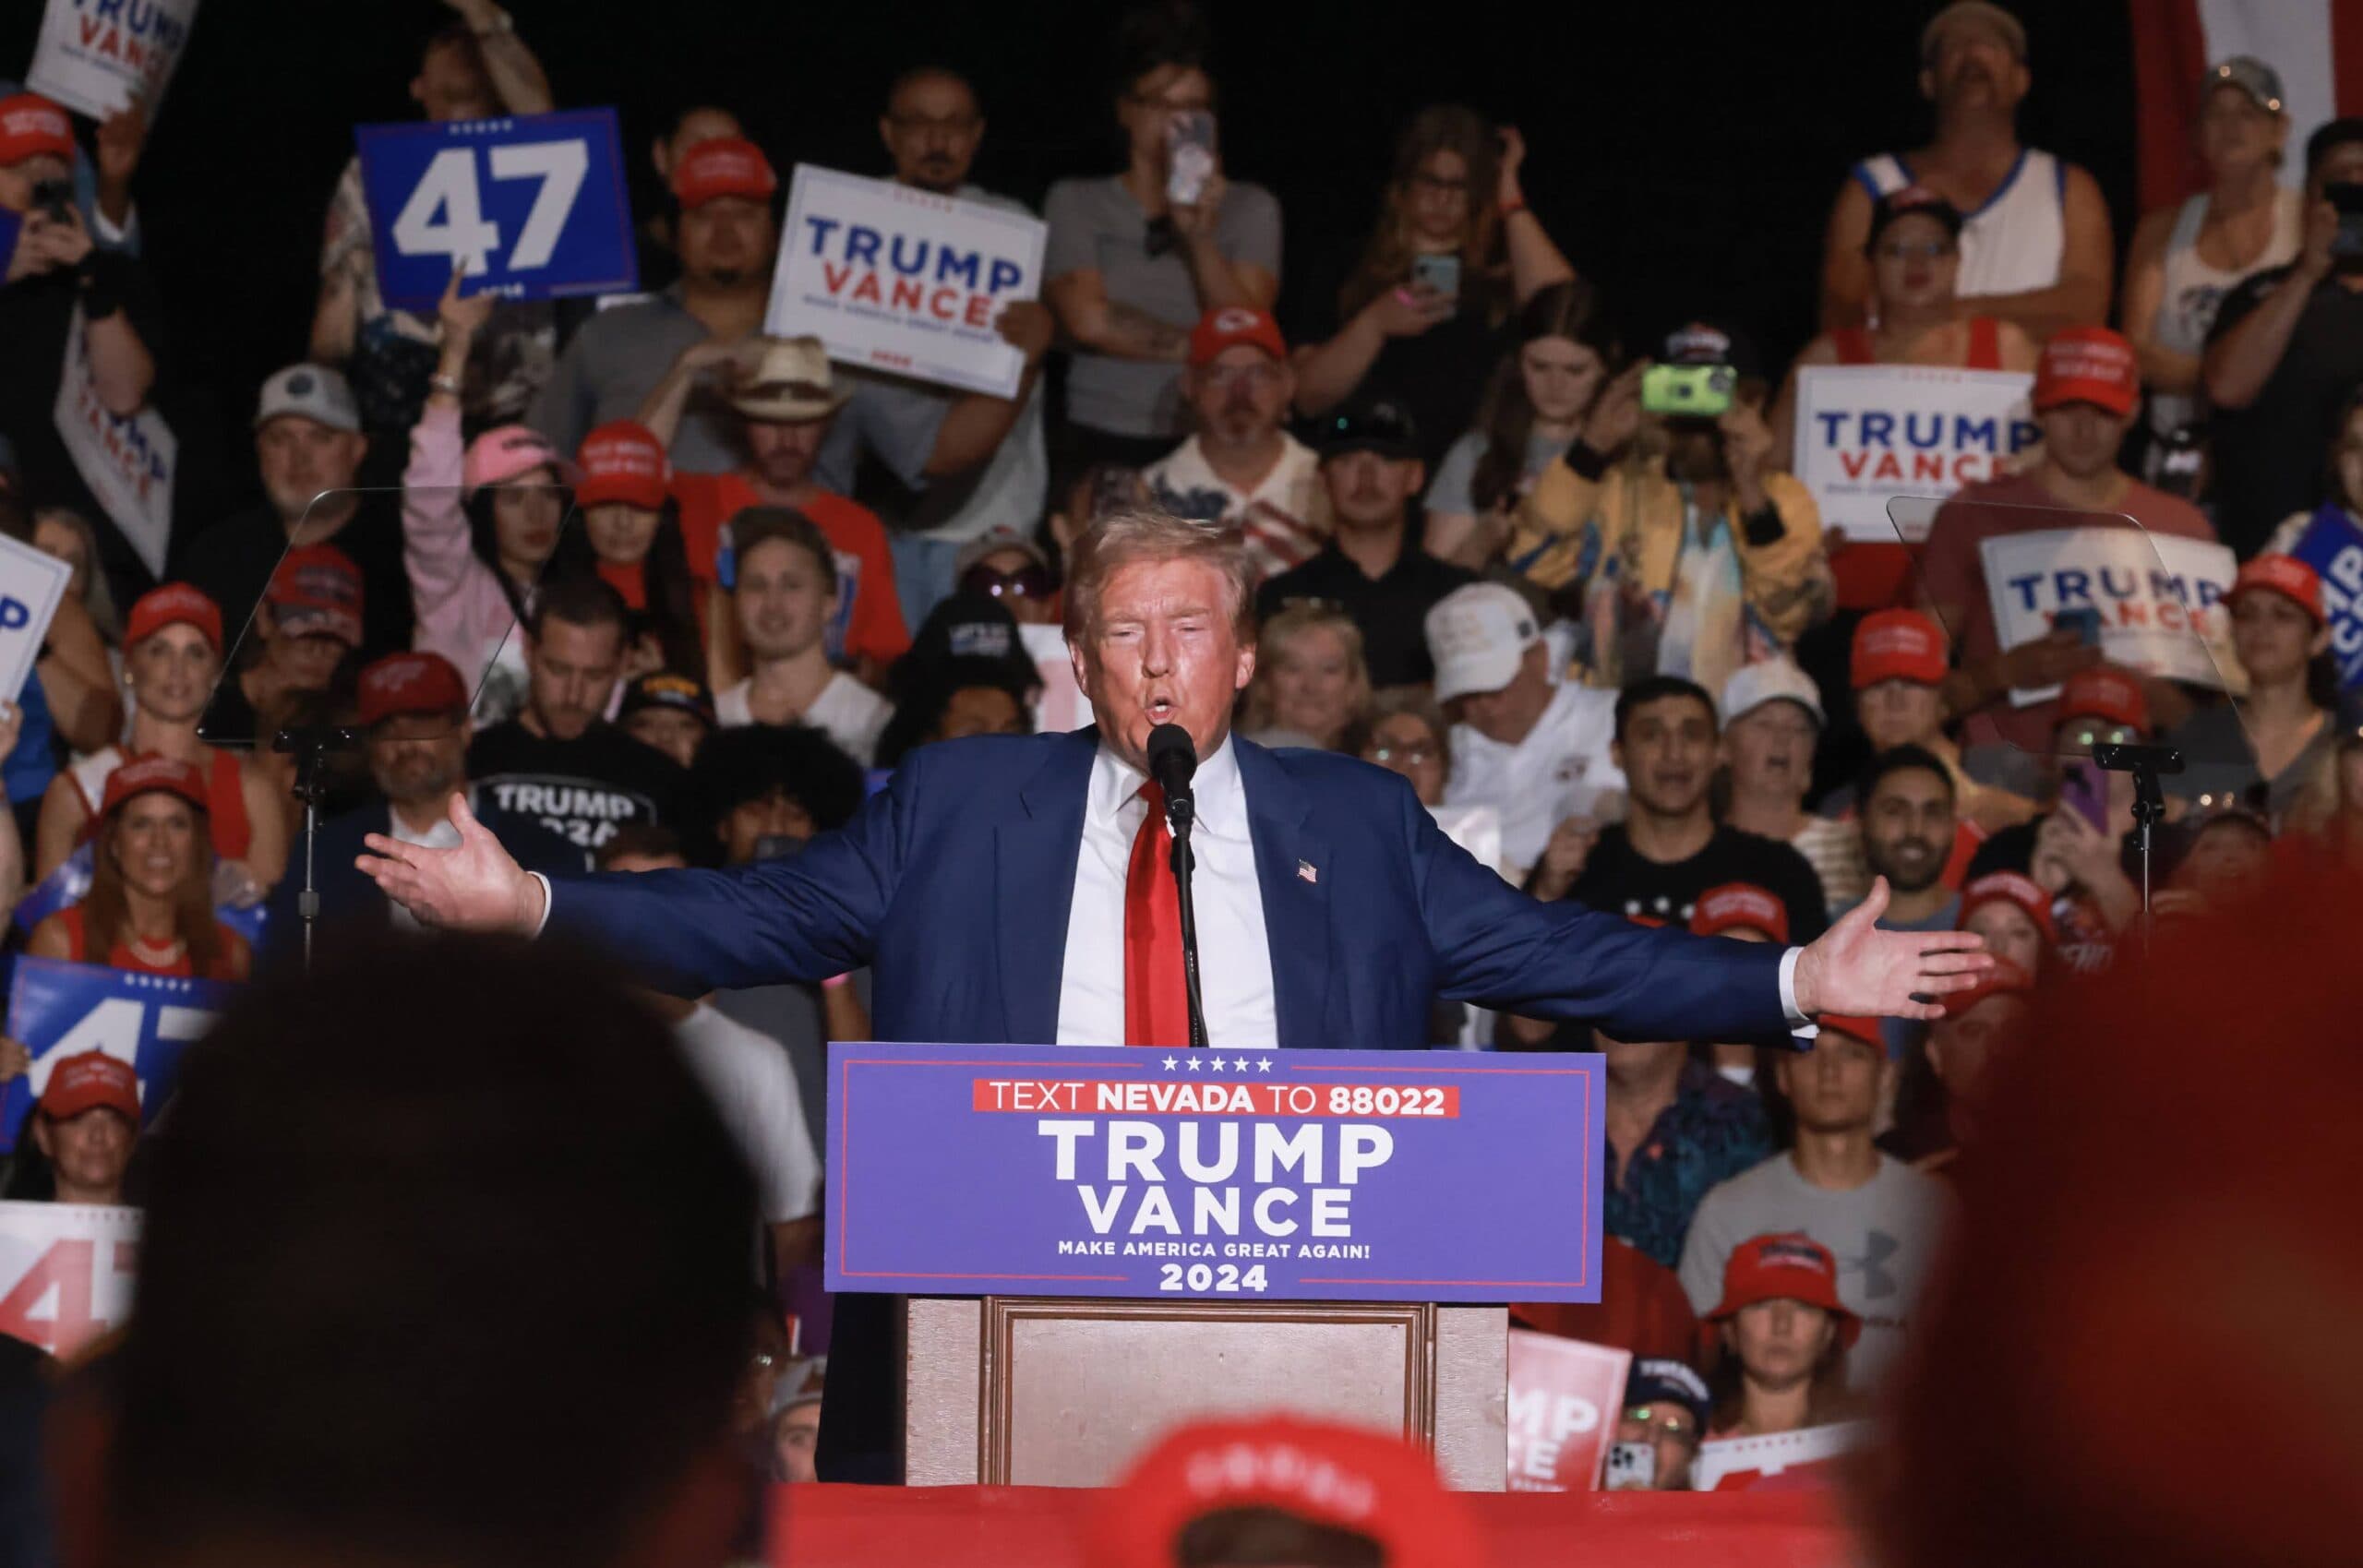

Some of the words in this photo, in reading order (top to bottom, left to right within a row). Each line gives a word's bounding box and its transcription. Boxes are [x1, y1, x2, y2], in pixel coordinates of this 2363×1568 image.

[391, 138, 591, 277] 47
[805, 213, 1022, 294] TRUMP
[823, 260, 994, 327] VANCE
[1817, 412, 2044, 454] TRUMP
[2009, 566, 2223, 611] TRUMP
[493, 784, 635, 820] TRUMP
[990, 1081, 1086, 1110] TEXT
[1097, 1083, 1255, 1113] NEVADA
[1266, 1085, 1316, 1114] TO
[1329, 1086, 1445, 1116] 88022
[1038, 1119, 1394, 1184] TRUMP
[1076, 1185, 1351, 1237] VANCE
[1058, 1240, 1116, 1255] MAKE
[1122, 1241, 1217, 1256] AMERICA
[1224, 1243, 1291, 1257] GREAT
[1298, 1244, 1371, 1259] AGAIN!
[1159, 1263, 1268, 1292] 2024
